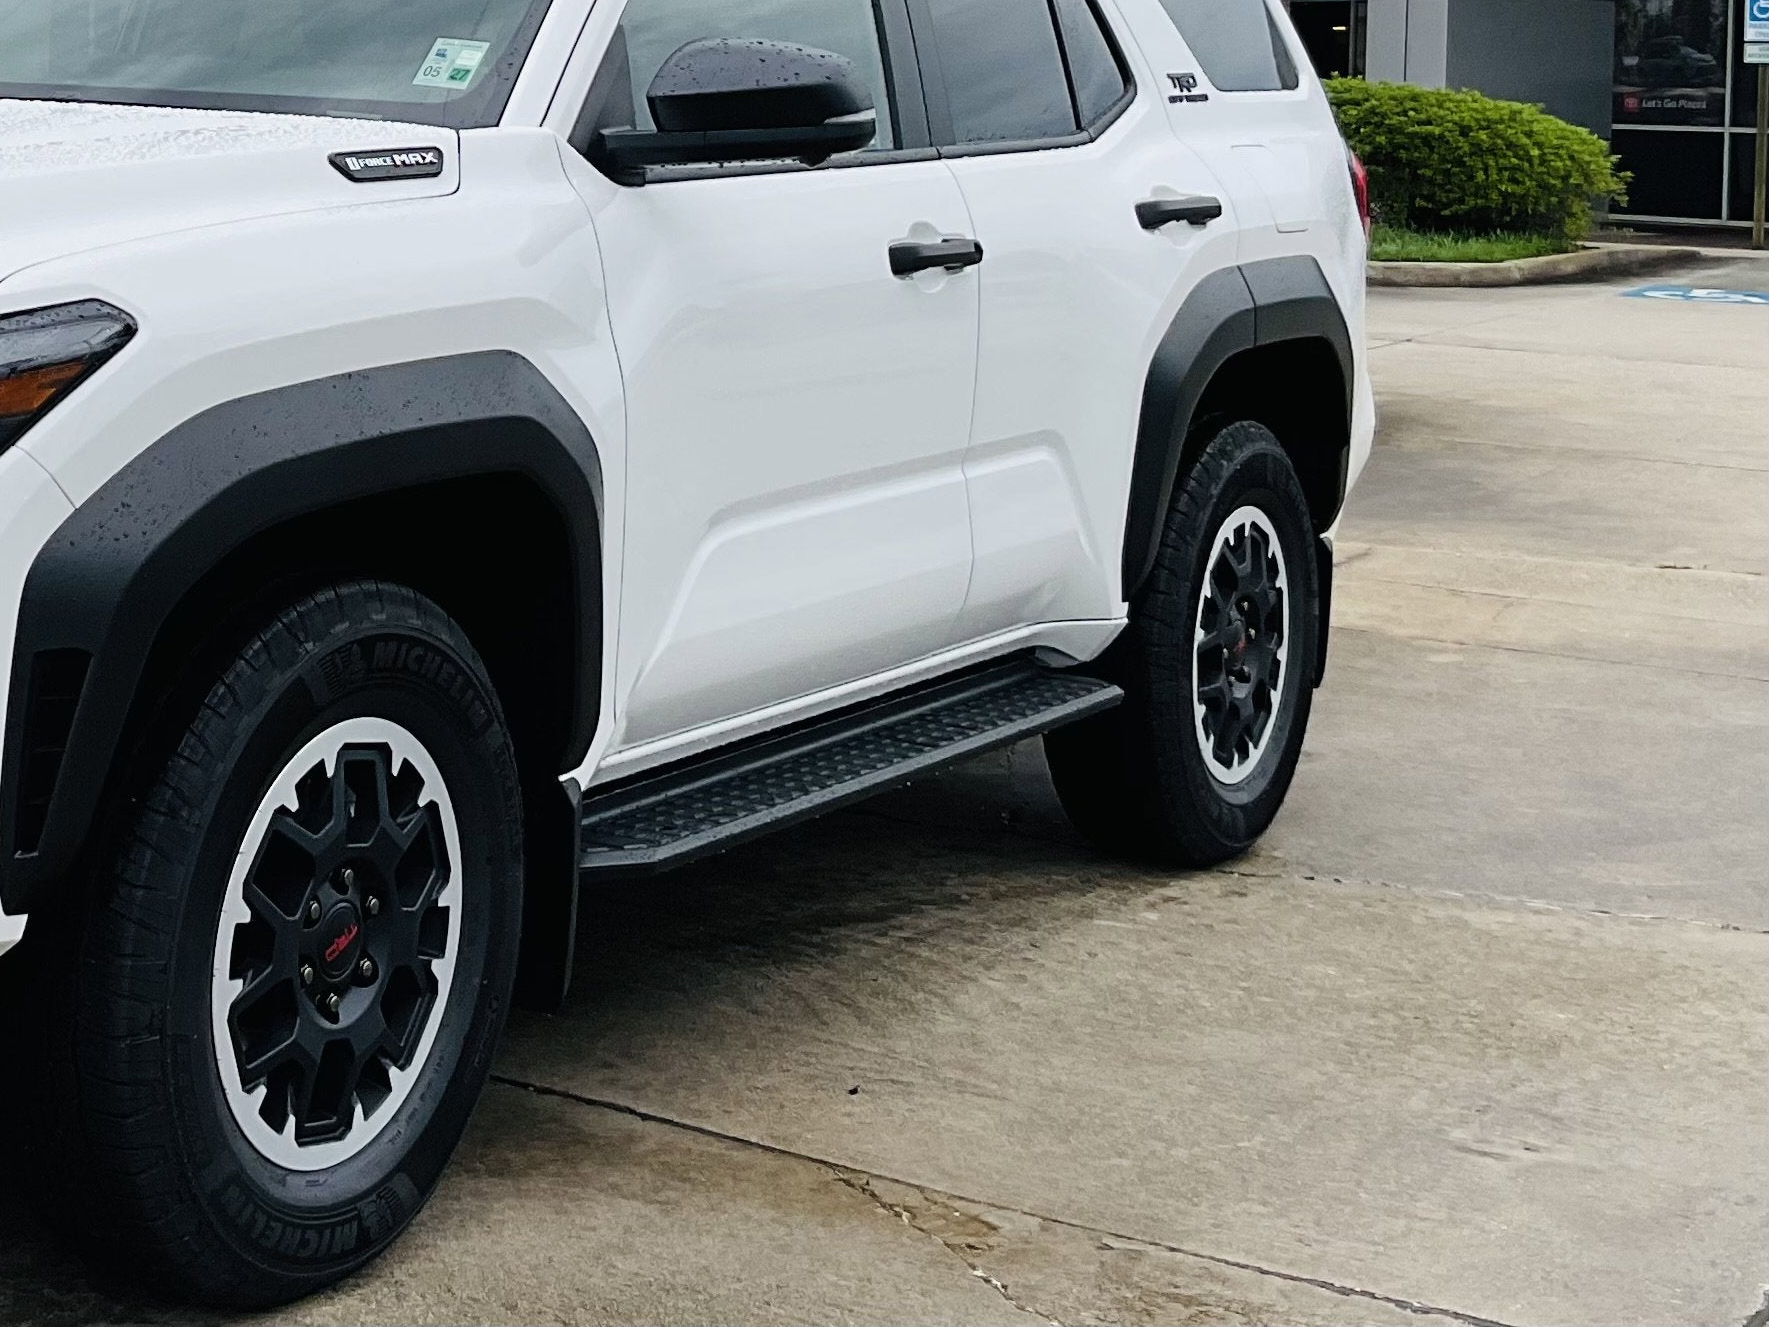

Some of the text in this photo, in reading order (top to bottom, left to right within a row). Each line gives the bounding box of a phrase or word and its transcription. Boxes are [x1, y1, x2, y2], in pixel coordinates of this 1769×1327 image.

[423, 65, 443, 78] 05
[448, 67, 472, 81] 27
[1166, 72, 1199, 93] TRD
[392, 151, 438, 167] MAX
